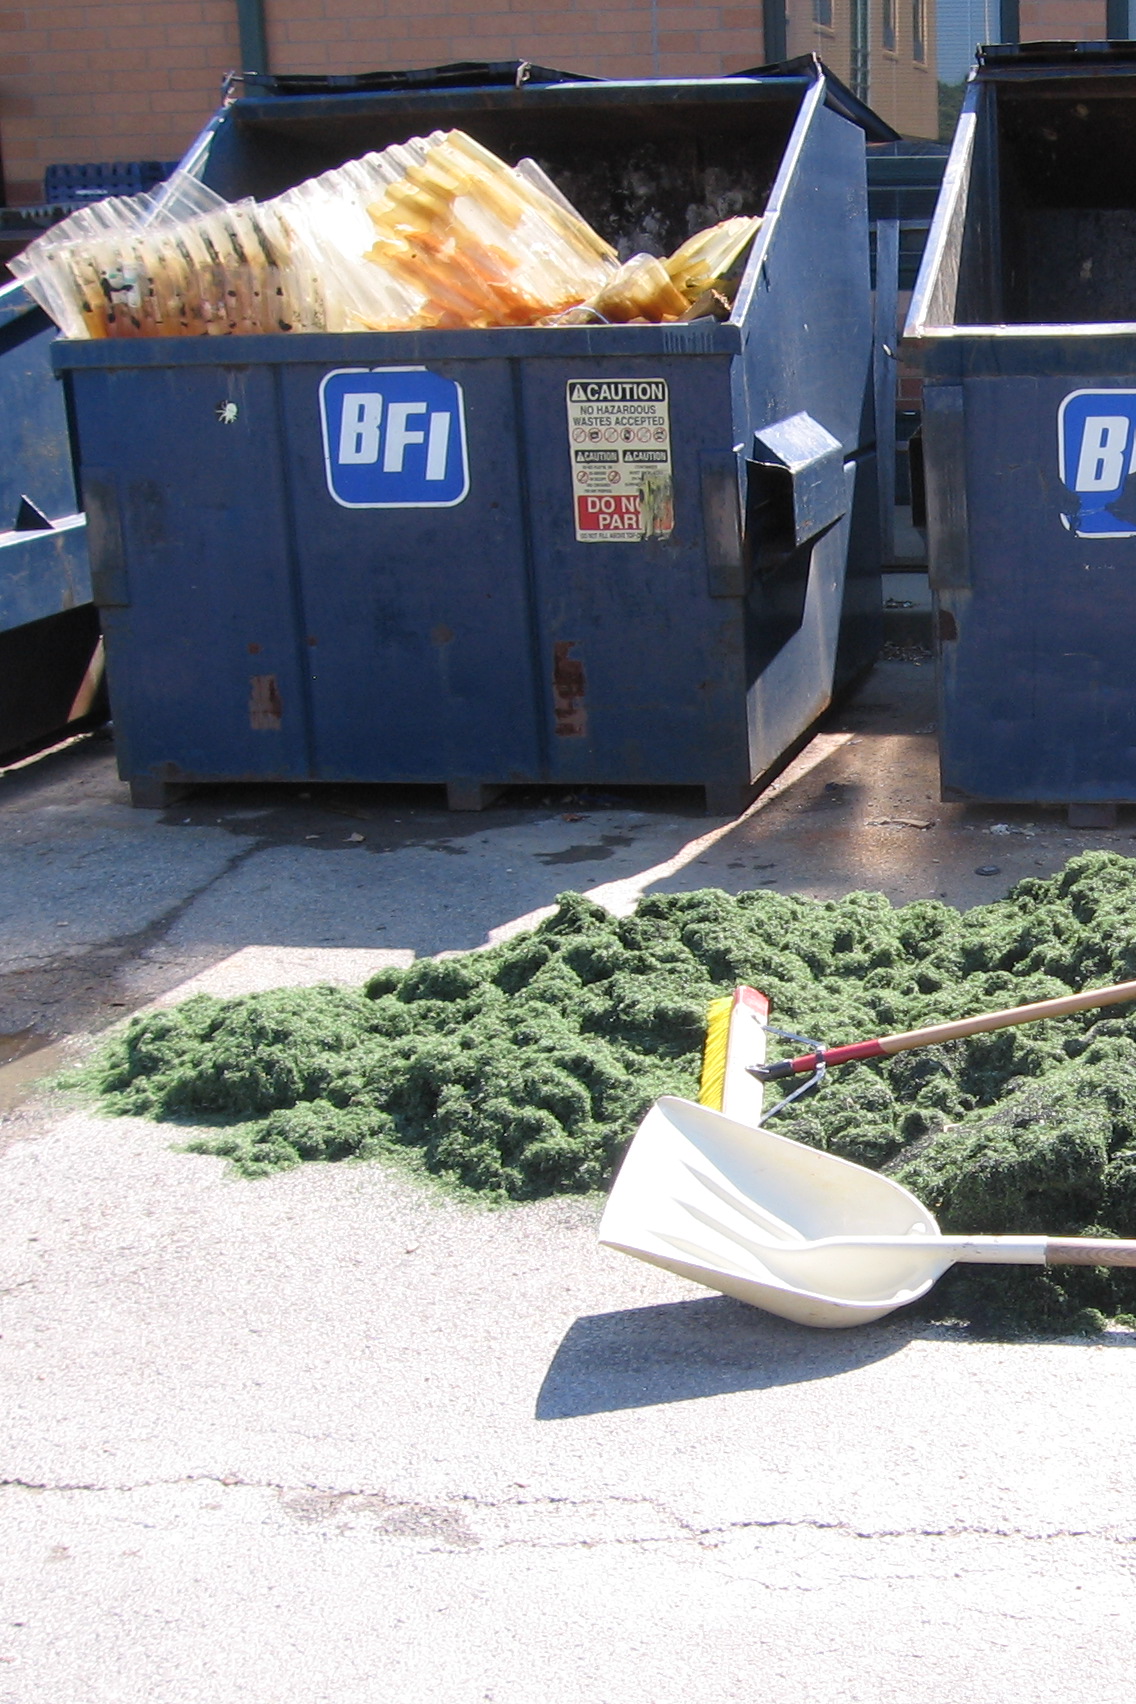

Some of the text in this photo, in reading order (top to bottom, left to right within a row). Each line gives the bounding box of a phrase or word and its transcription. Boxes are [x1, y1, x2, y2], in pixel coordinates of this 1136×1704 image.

[586, 383, 663, 401] CAUTION
[580, 405, 656, 415] NO HAZARDOUS
[573, 416, 665, 427] WASTES ACCEPTED
[338, 393, 451, 481] BFI
[584, 452, 618, 461] CAUTION
[633, 452, 666, 461] CAUTION
[587, 497, 616, 513] DO
